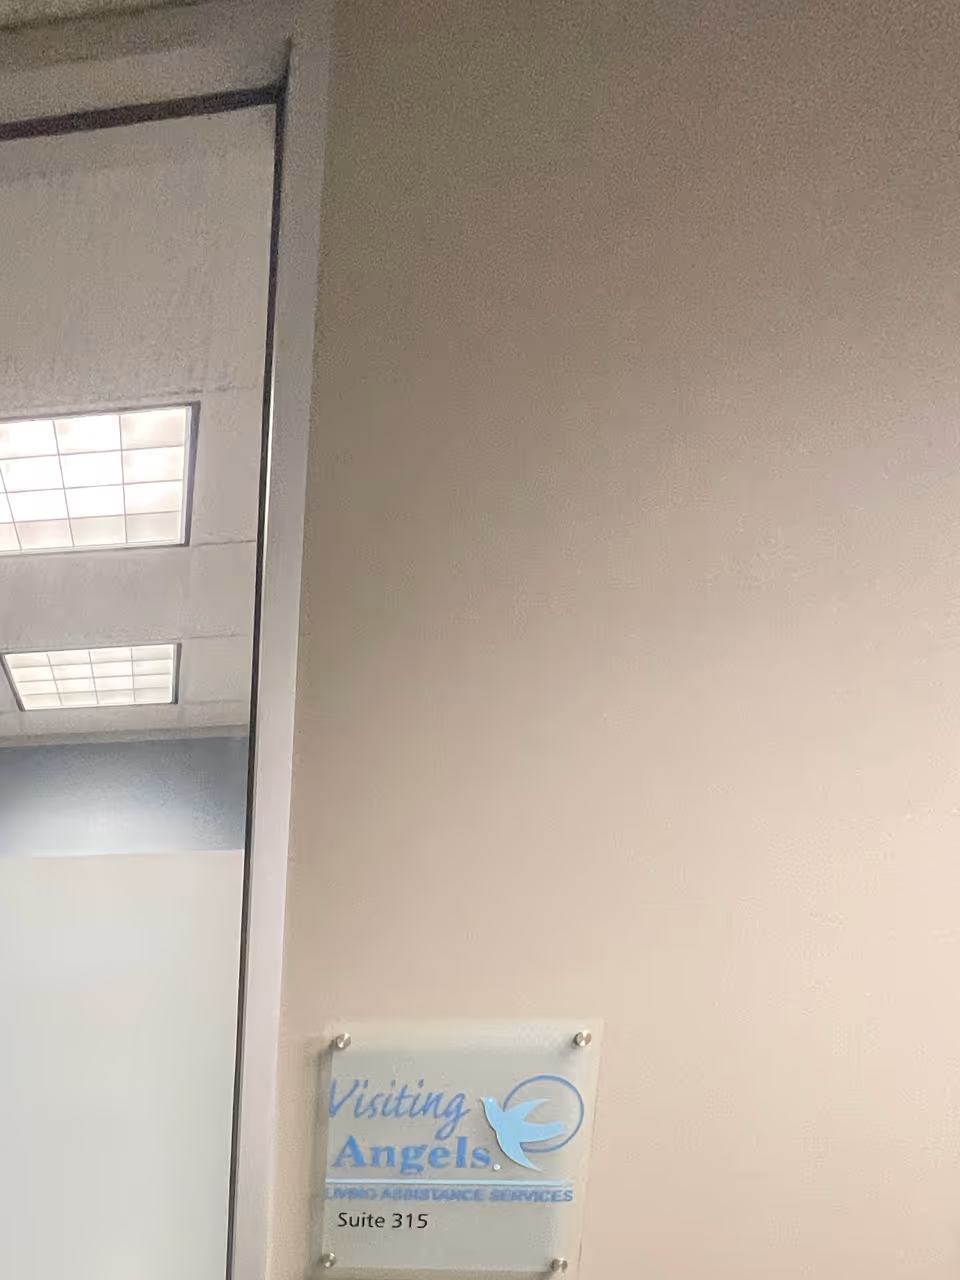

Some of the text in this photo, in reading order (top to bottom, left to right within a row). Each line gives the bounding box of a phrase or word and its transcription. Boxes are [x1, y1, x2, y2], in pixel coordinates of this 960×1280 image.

[328, 1079, 471, 1140] Visiting
[332, 1135, 493, 1174] Angels
[381, 1187, 484, 1201] ASSISTANCE
[490, 1188, 573, 1202] SERVICES
[337, 1212, 428, 1229] Suite 315
